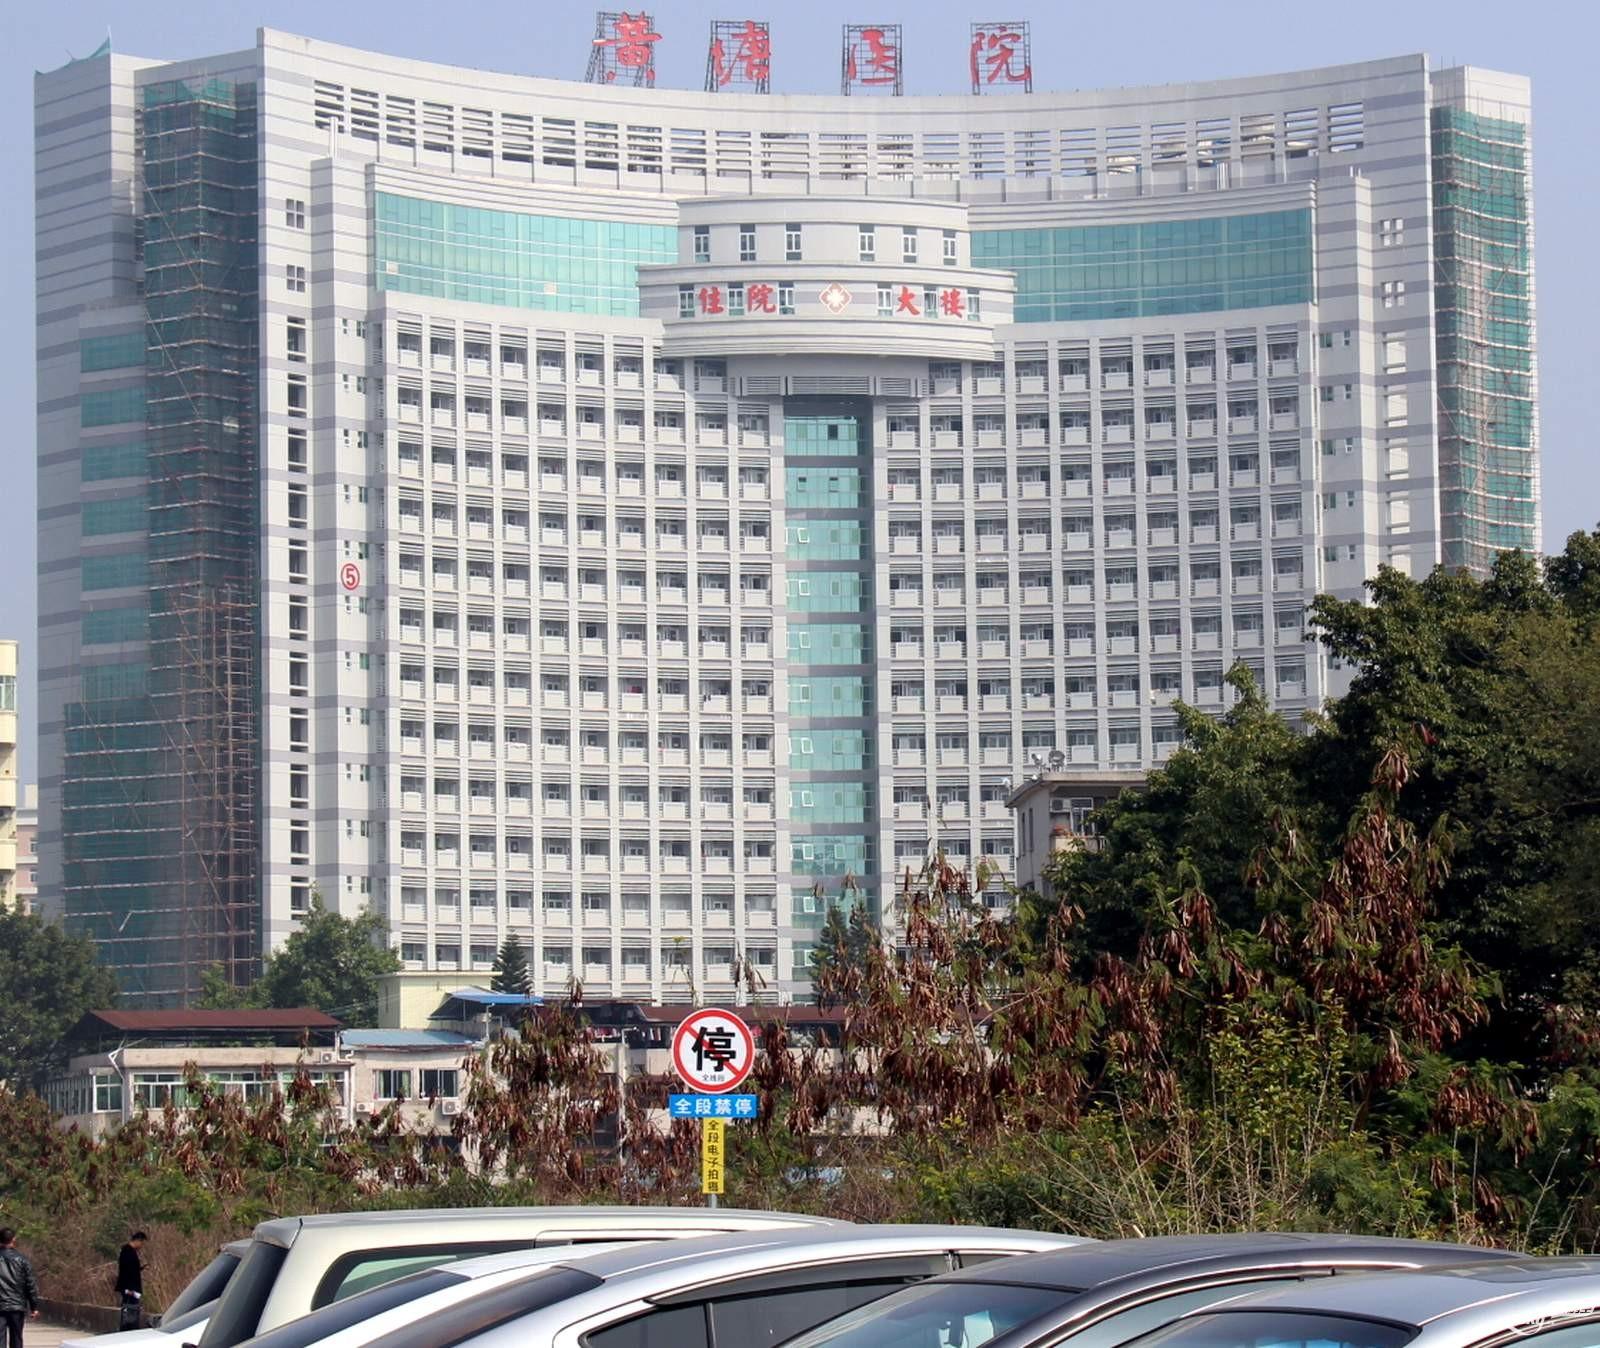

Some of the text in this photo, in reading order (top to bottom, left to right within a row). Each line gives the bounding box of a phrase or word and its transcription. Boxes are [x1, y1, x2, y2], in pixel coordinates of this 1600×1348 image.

[592, 11, 1031, 85] 黄塘医院
[698, 284, 965, 318] 住院 大楼
[692, 1026, 736, 1072] 停
[675, 1098, 752, 1115] 全段禁停
